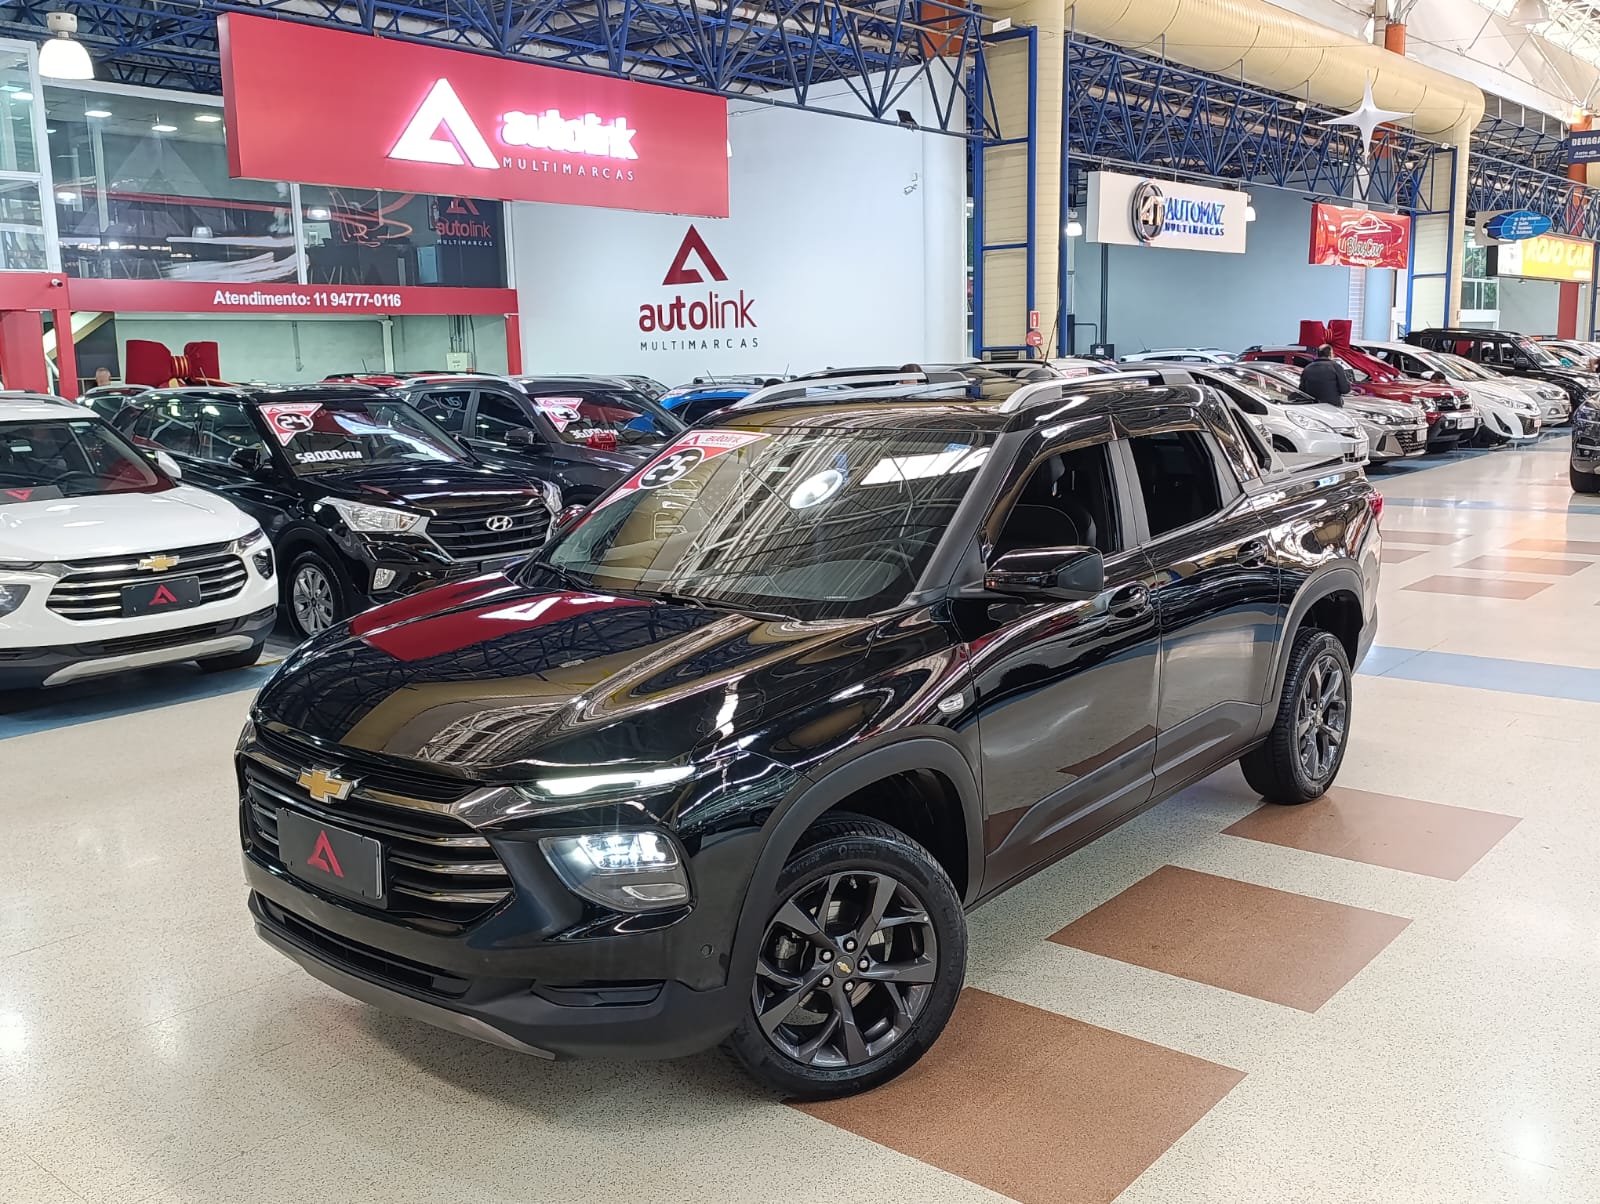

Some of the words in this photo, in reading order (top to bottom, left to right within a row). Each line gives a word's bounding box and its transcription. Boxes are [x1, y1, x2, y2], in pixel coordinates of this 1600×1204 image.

[501, 109, 638, 159] autolink
[503, 155, 636, 181] MULTIMARCAS
[1165, 197, 1226, 225] AUTOMAZ
[436, 220, 492, 237] autolink
[1164, 222, 1225, 236] MULTIMARCAS
[437, 239, 493, 247] MULTIMARCAS
[213, 290, 311, 306] Atendimento:
[313, 293, 328, 306] 11
[330, 293, 402, 307] 94777-0116
[639, 289, 758, 332] autolink
[640, 337, 759, 351] MULTIMARCAS
[279, 415, 310, 429] 24
[644, 455, 698, 481] 25
